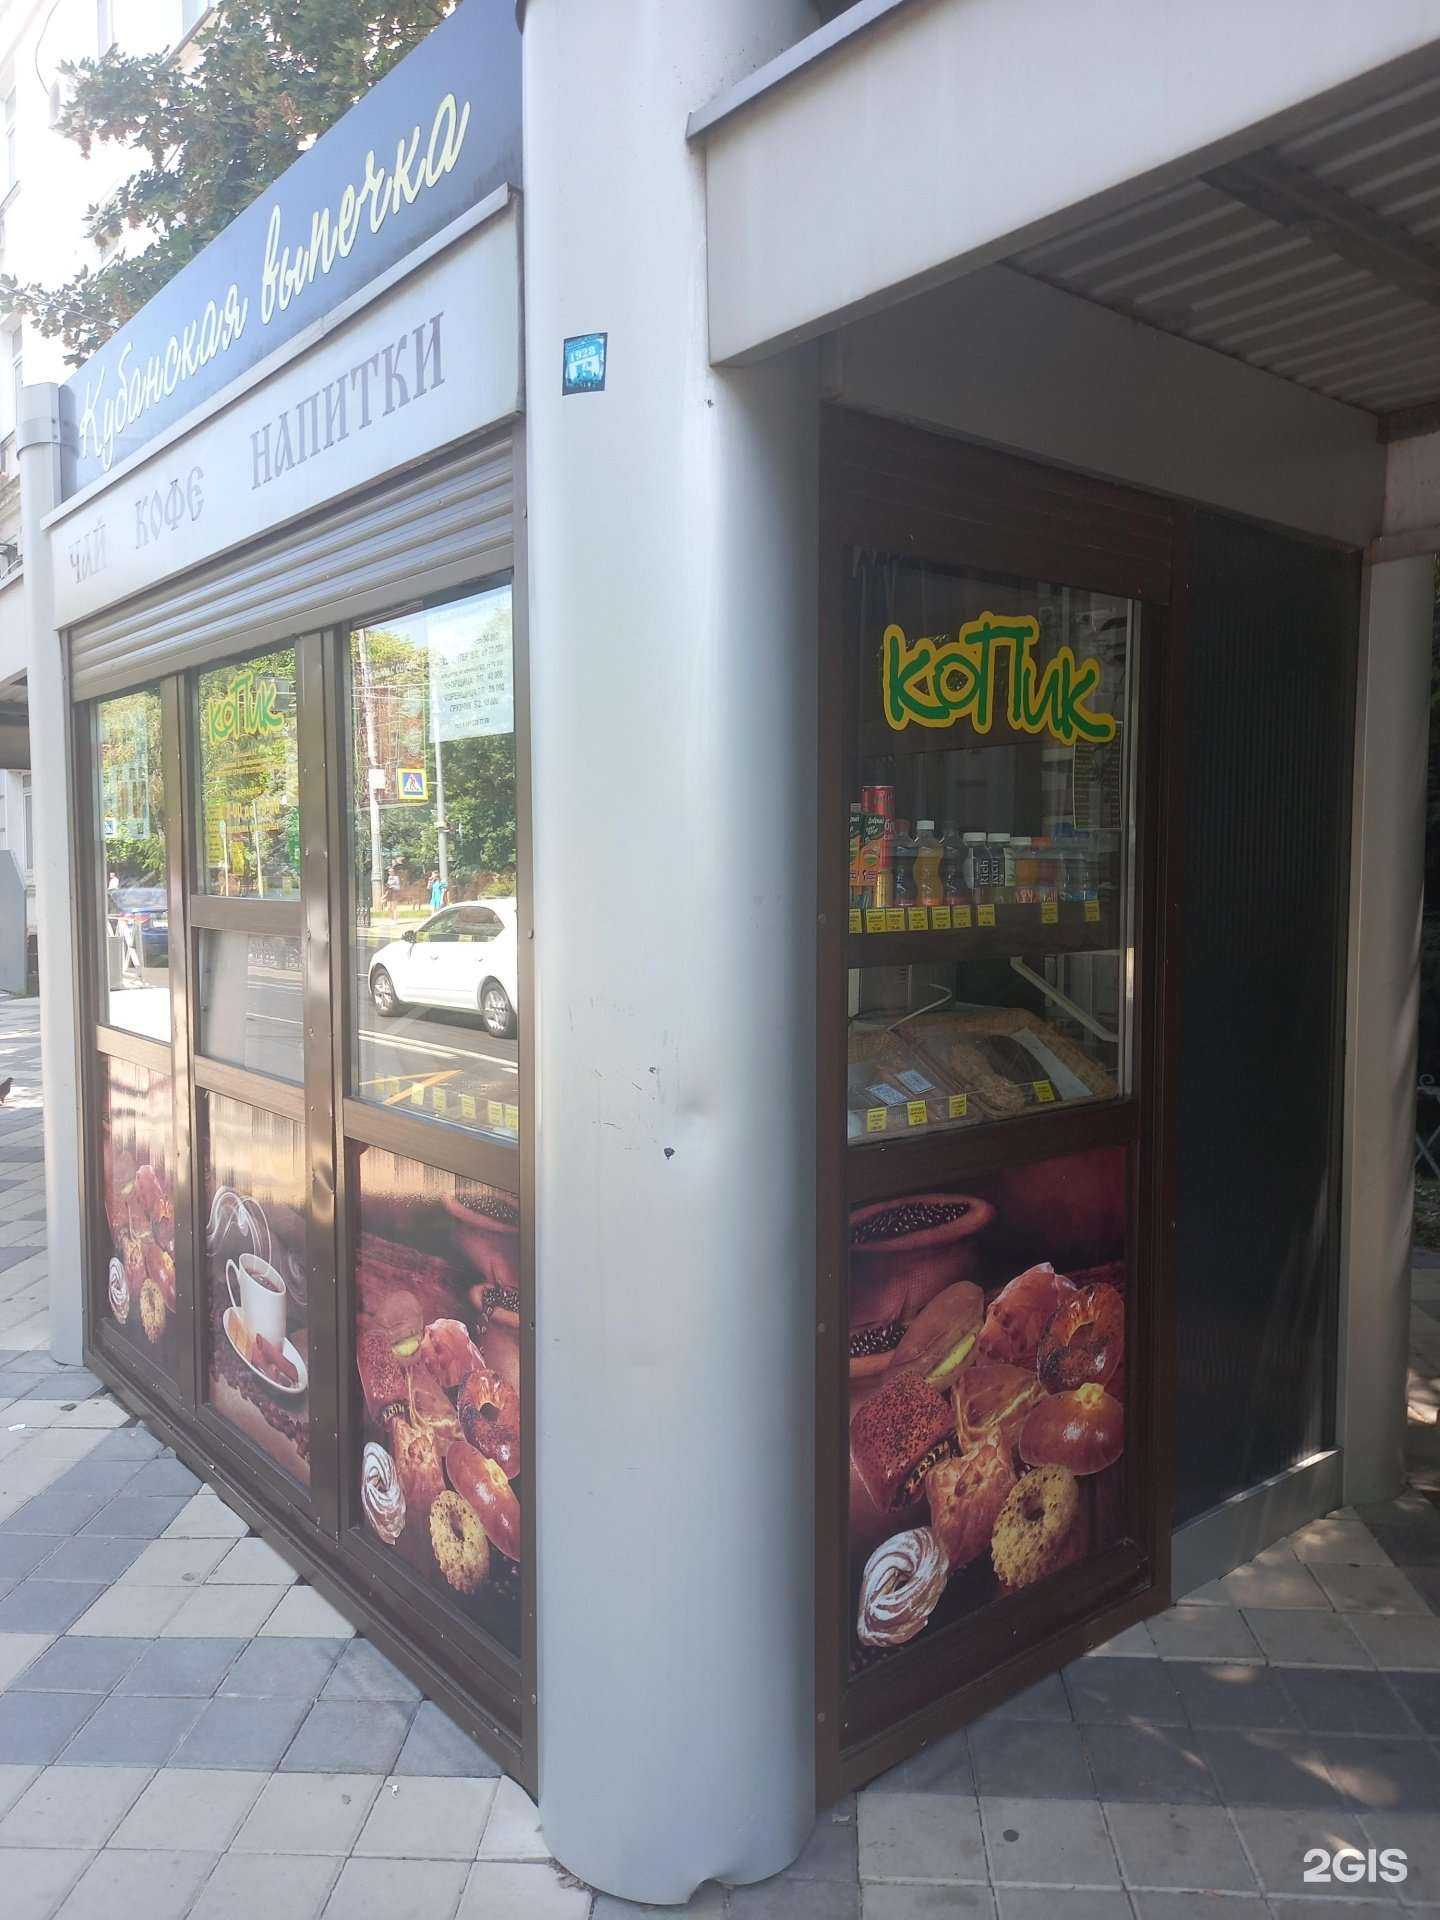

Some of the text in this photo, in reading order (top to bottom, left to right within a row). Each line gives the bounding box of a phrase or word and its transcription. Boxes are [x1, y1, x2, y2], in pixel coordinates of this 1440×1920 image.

[79, 93, 470, 472] Кубанская выпечка
[250, 311, 446, 491] НАПИТКИ
